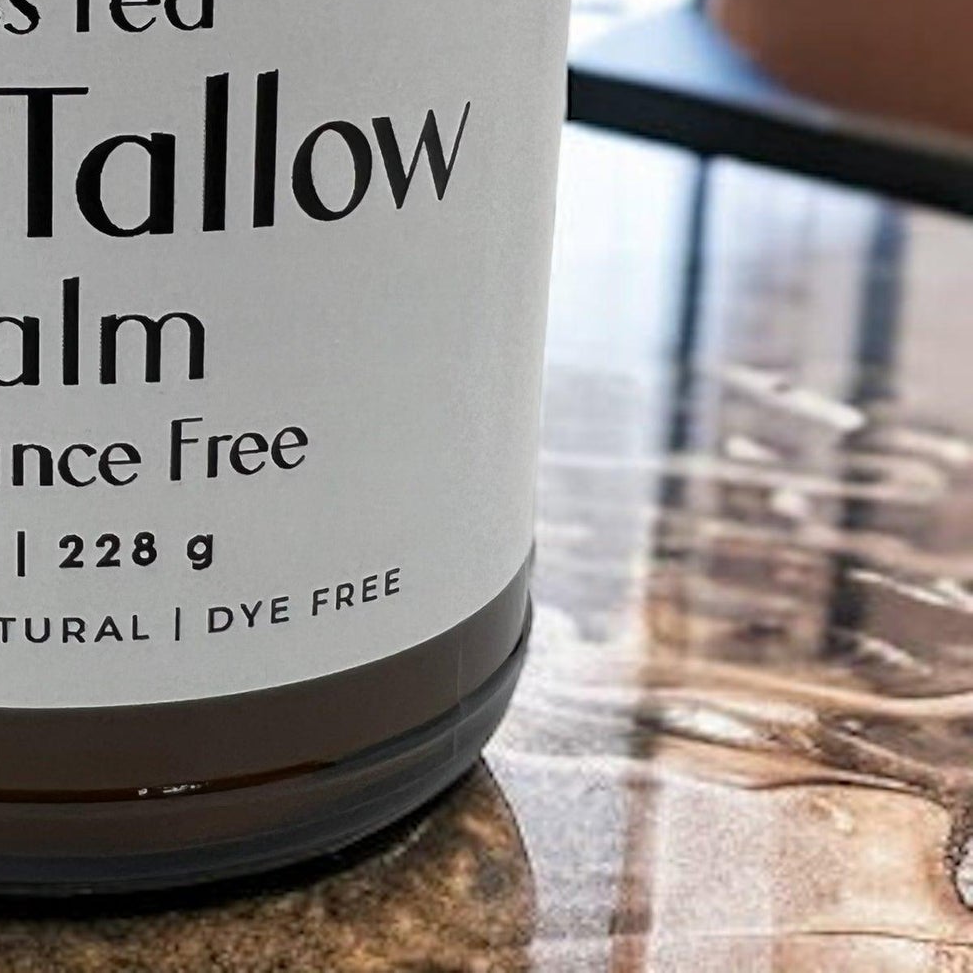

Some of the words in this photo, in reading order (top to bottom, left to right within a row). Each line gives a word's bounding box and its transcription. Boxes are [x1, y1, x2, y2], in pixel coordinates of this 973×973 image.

[169, 417, 309, 482] Free
[58, 531, 158, 569] 228
[186, 533, 214, 571] g
[207, 595, 290, 634] DYE
[311, 567, 402, 617] FREE
